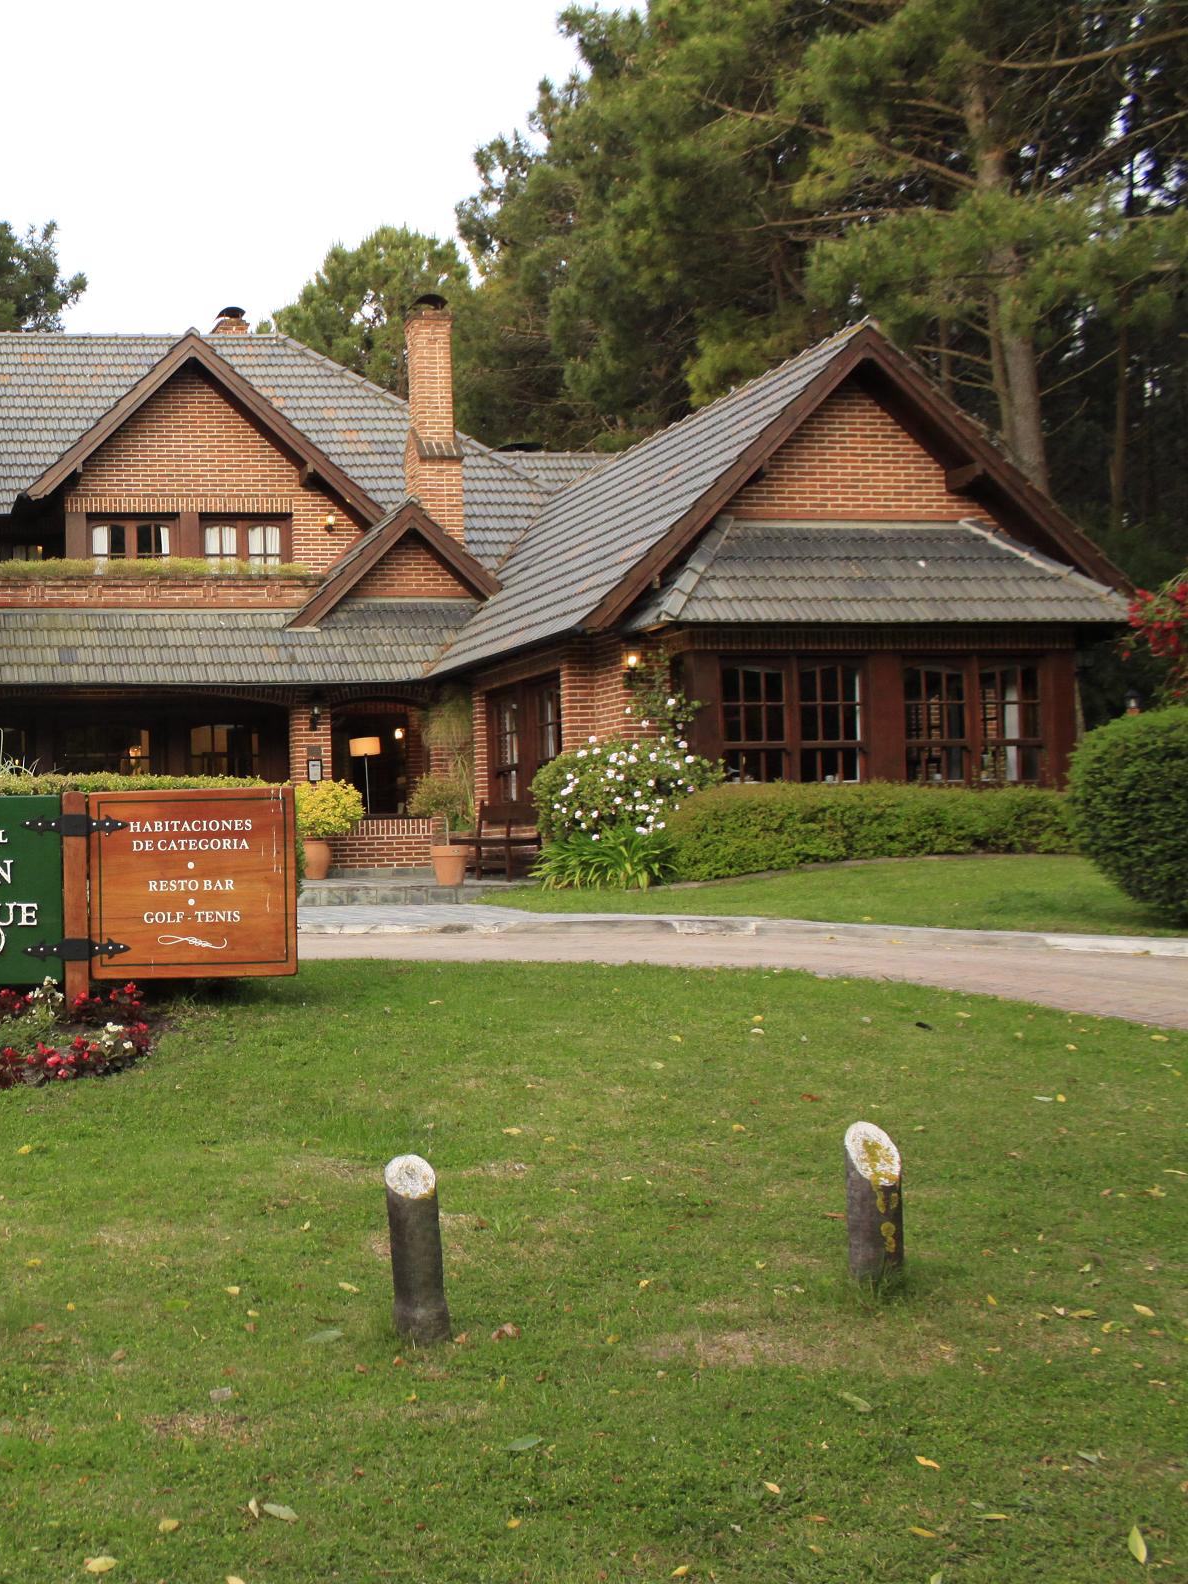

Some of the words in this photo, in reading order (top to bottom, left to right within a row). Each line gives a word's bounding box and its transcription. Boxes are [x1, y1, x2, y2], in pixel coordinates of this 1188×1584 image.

[129, 819, 253, 833] HABITACIONES
[132, 840, 153, 852] DE
[157, 838, 250, 851] CATEGORIA
[148, 880, 199, 892] RESTO
[203, 879, 235, 891] BAR
[143, 911, 185, 924] GOLF
[194, 910, 241, 923] TENIS
